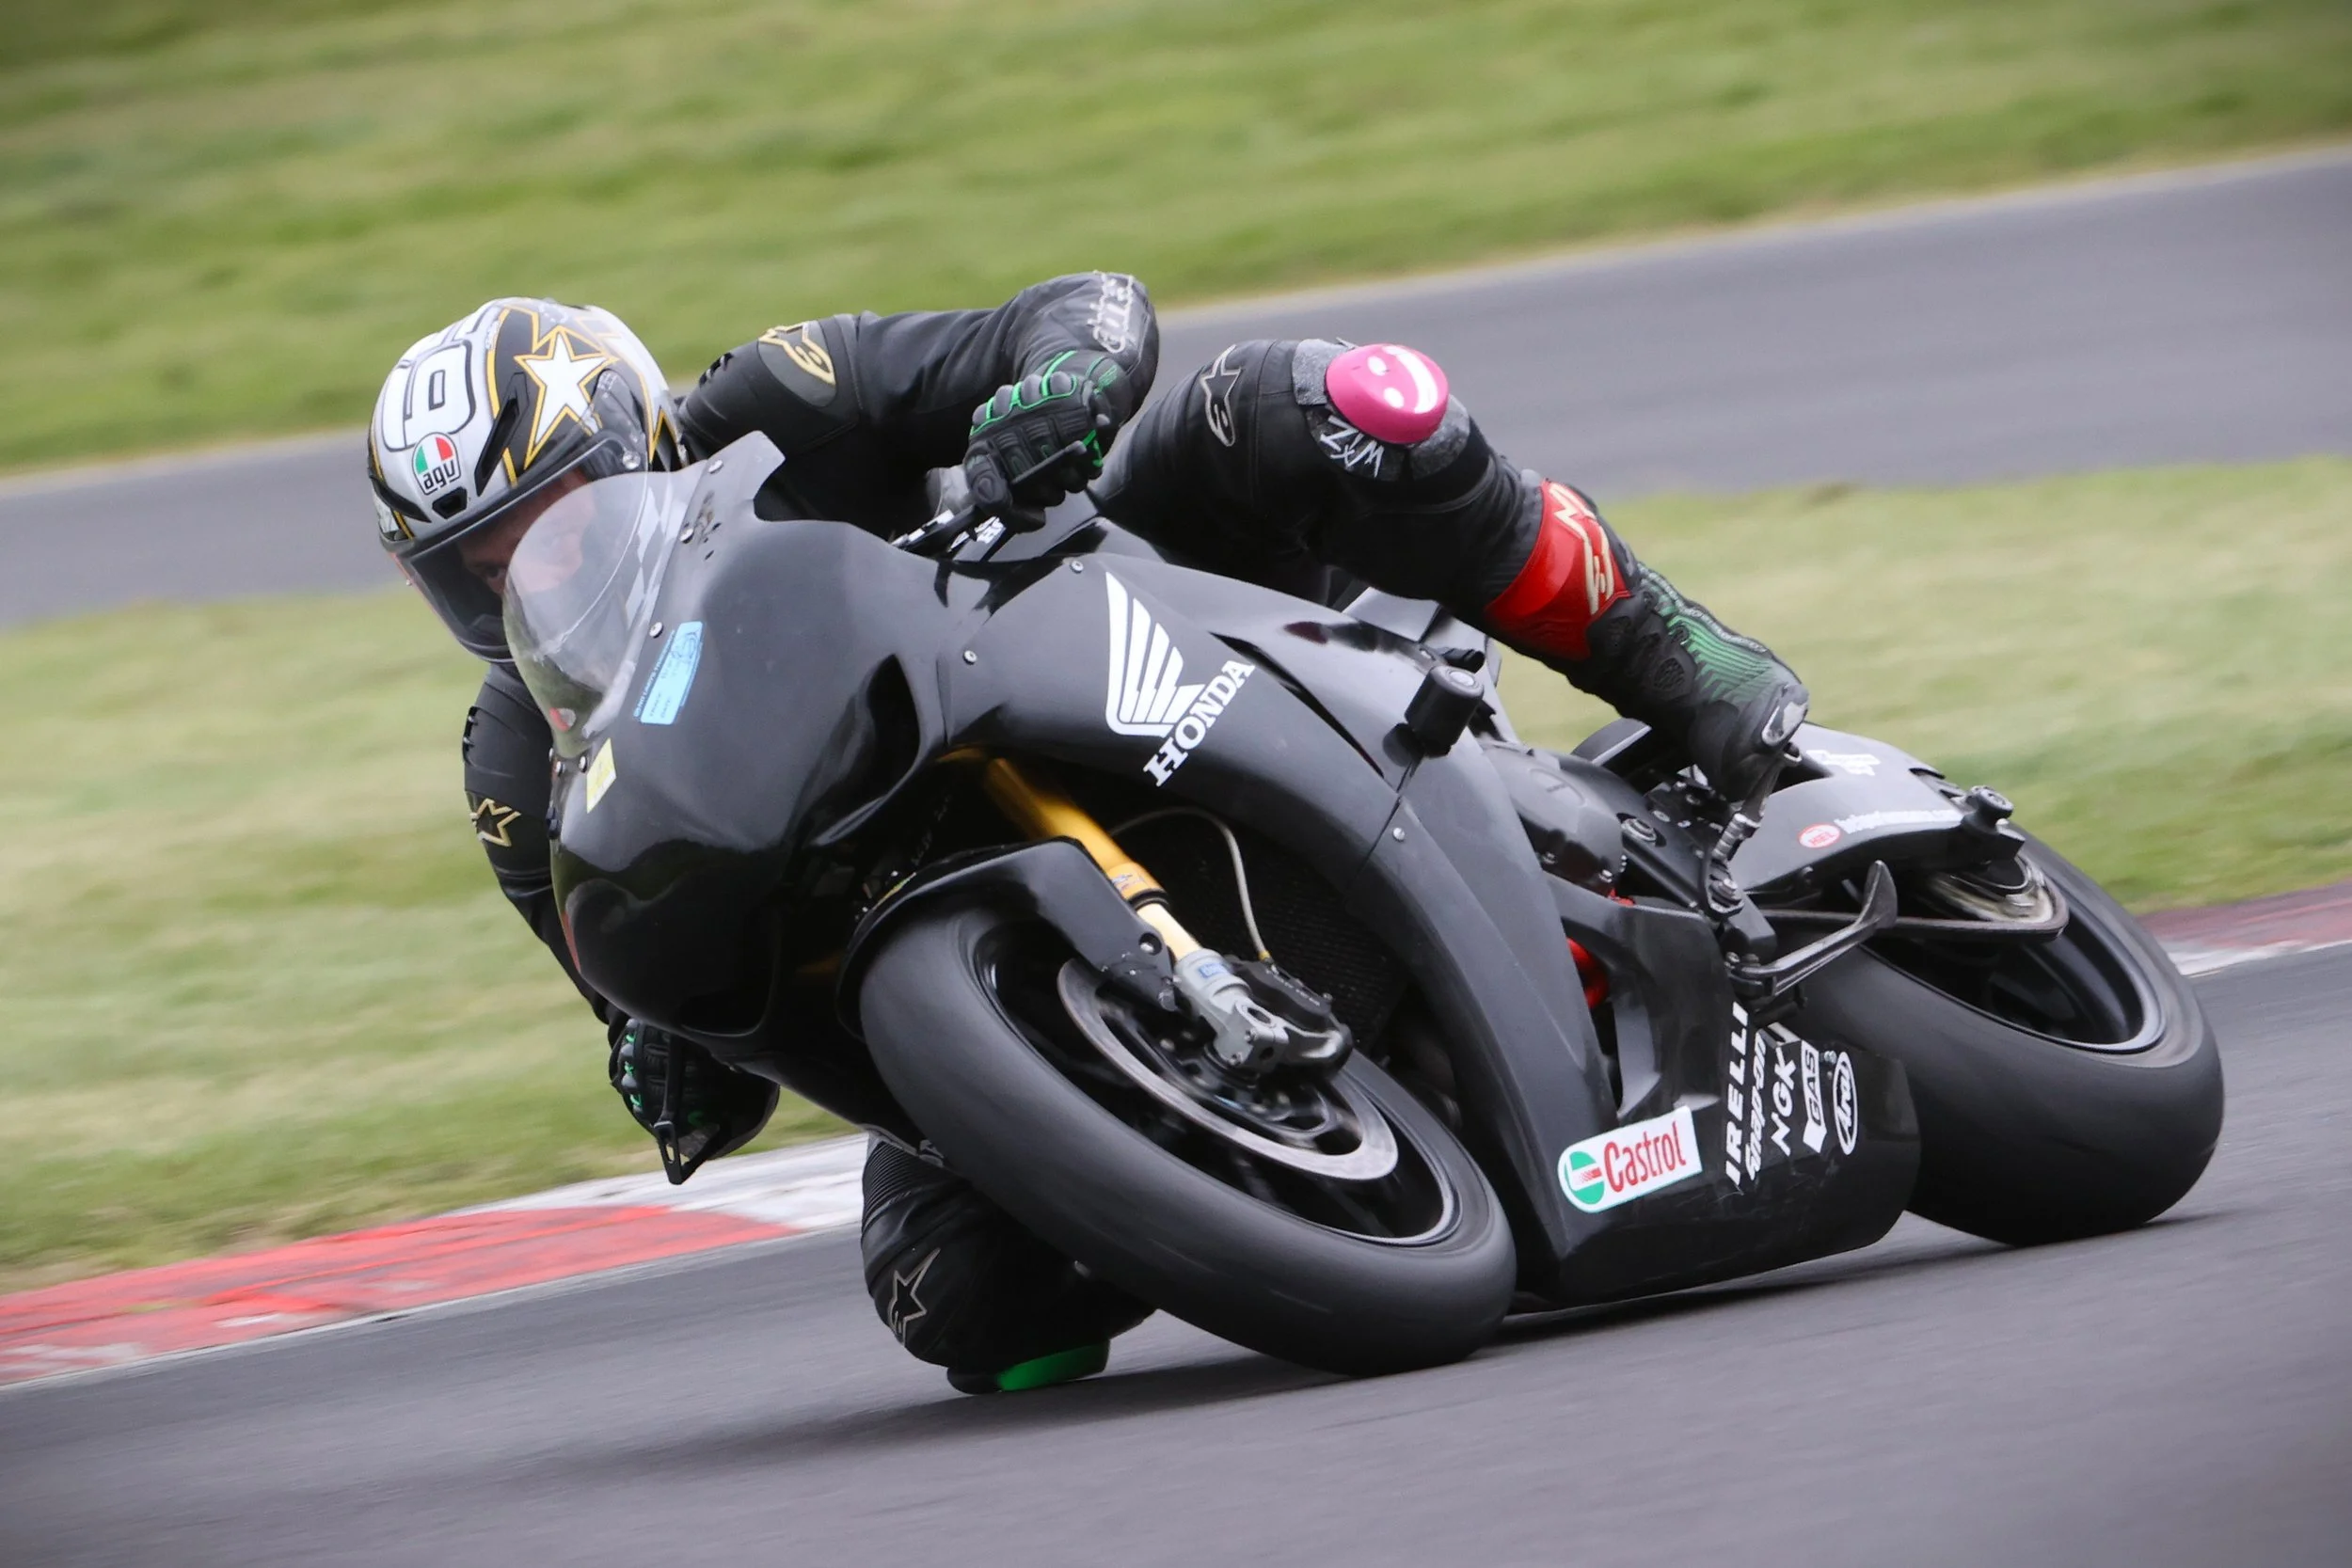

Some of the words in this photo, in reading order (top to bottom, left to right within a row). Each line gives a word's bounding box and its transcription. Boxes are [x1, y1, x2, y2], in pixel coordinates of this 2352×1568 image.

[1143, 659, 1256, 787] HONDA
[1771, 1047, 1797, 1157] NGK
[1804, 1049, 1822, 1127] GAS
[1836, 1061, 1853, 1146] Arai
[1604, 1120, 1687, 1193] Castrol
